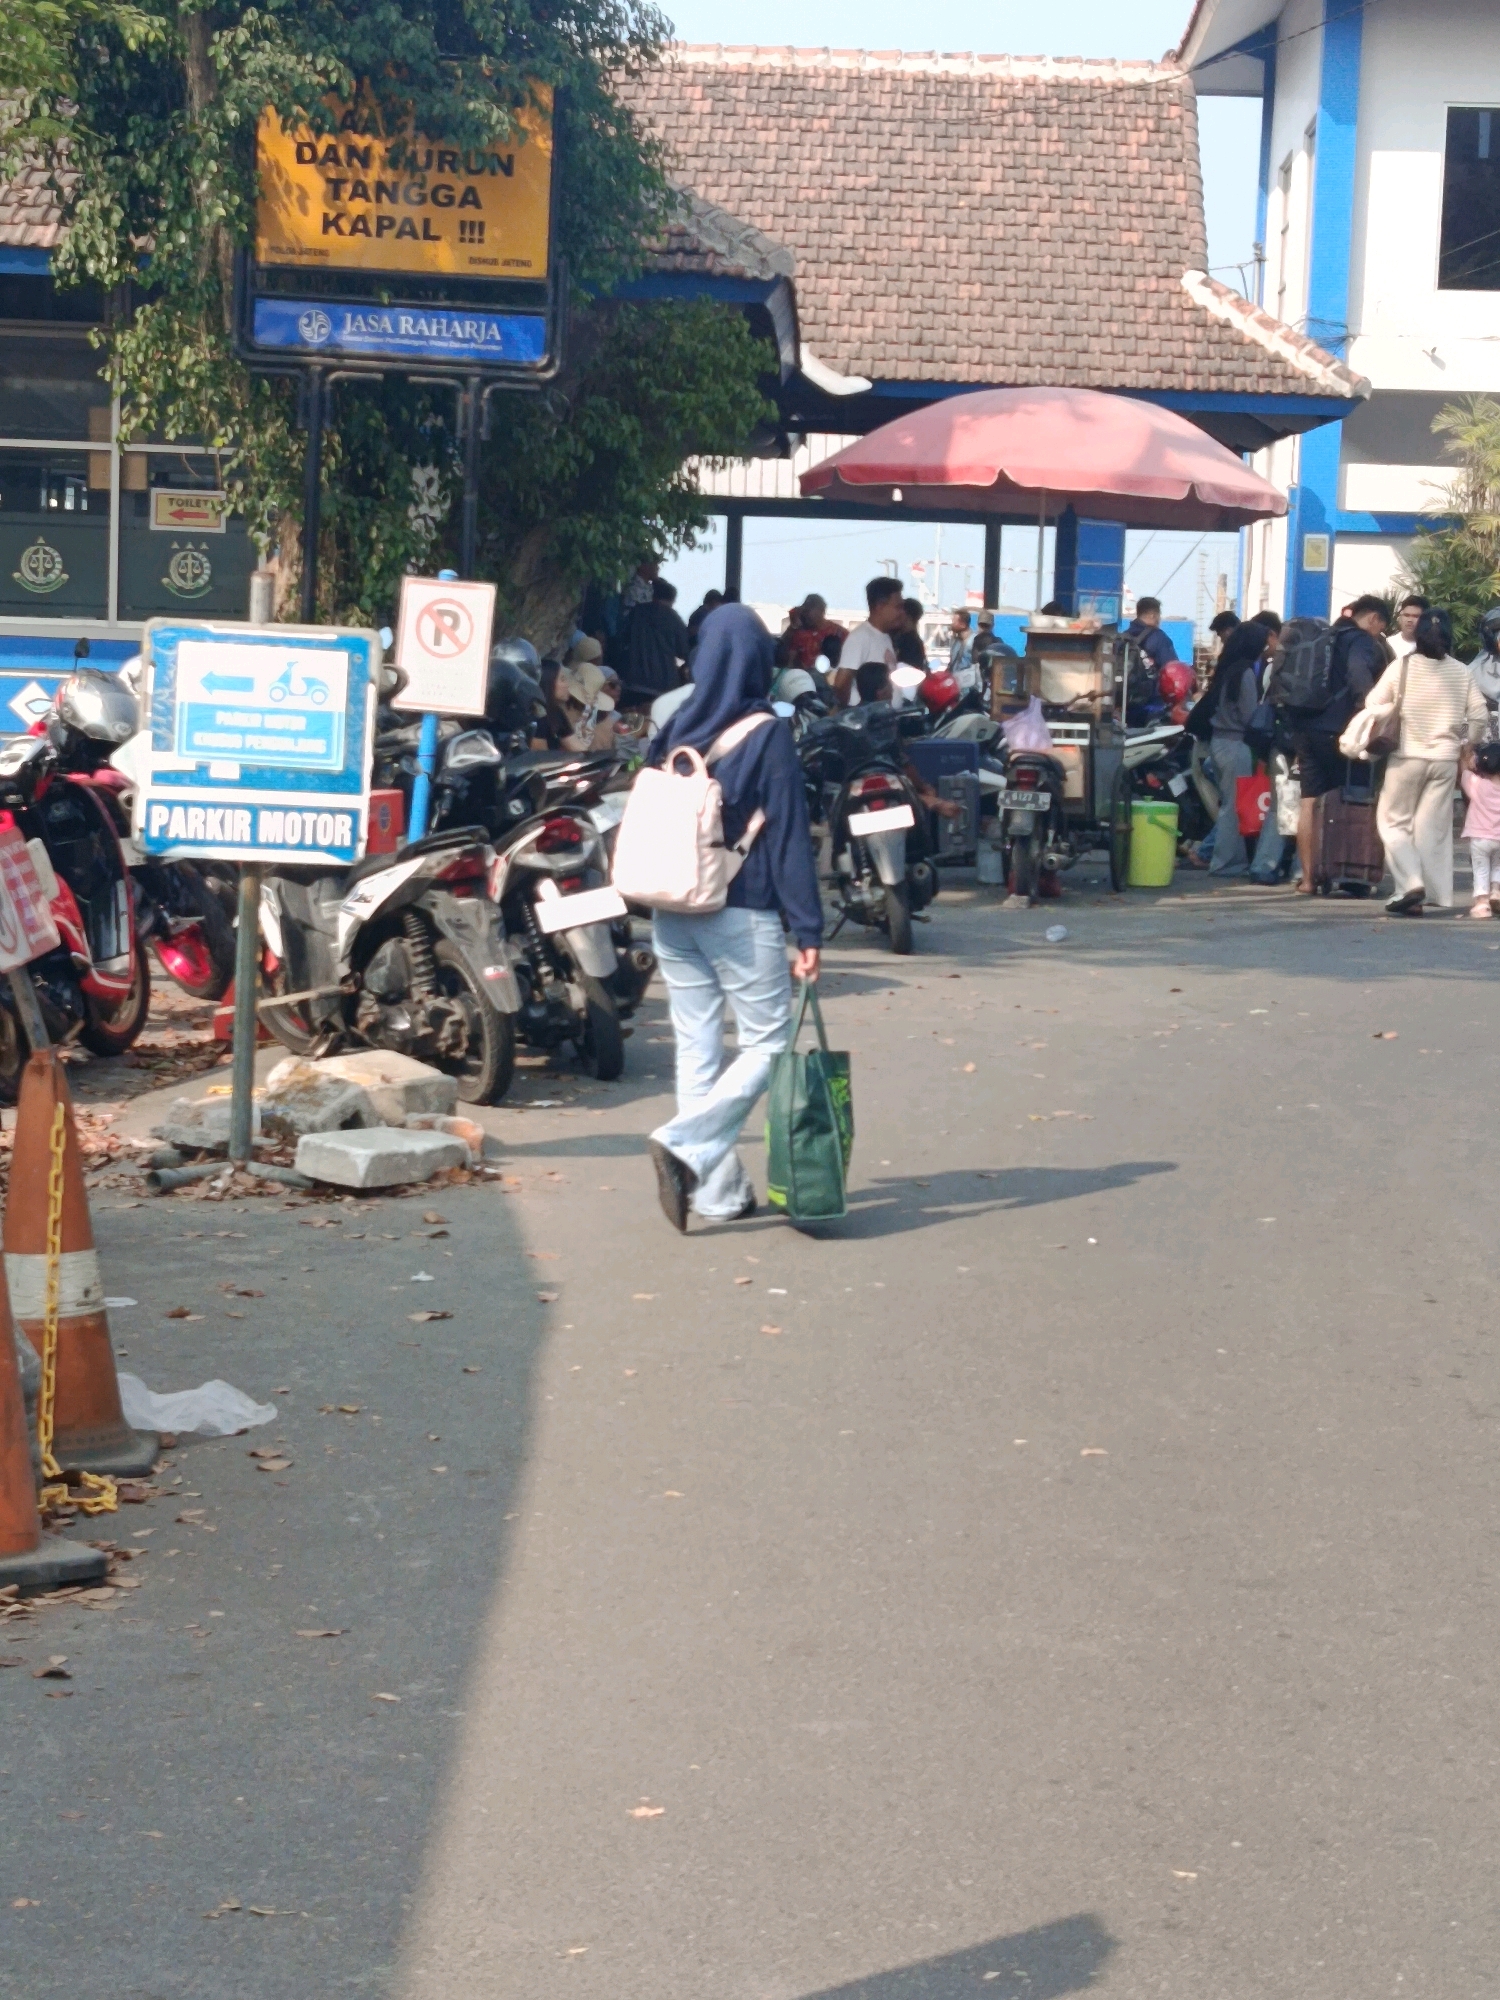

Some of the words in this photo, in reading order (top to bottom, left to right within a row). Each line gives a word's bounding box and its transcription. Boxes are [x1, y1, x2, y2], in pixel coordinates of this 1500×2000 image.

[295, 141, 371, 169] DAN
[326, 178, 483, 209] TANGGA
[321, 212, 442, 242] KAPAL
[458, 219, 486, 244] !!!
[343, 312, 393, 335] JASA
[399, 316, 502, 343] RAHARJA
[168, 497, 209, 508] TOILET
[152, 805, 252, 841] PARKIR
[258, 810, 353, 847] MOTOR
